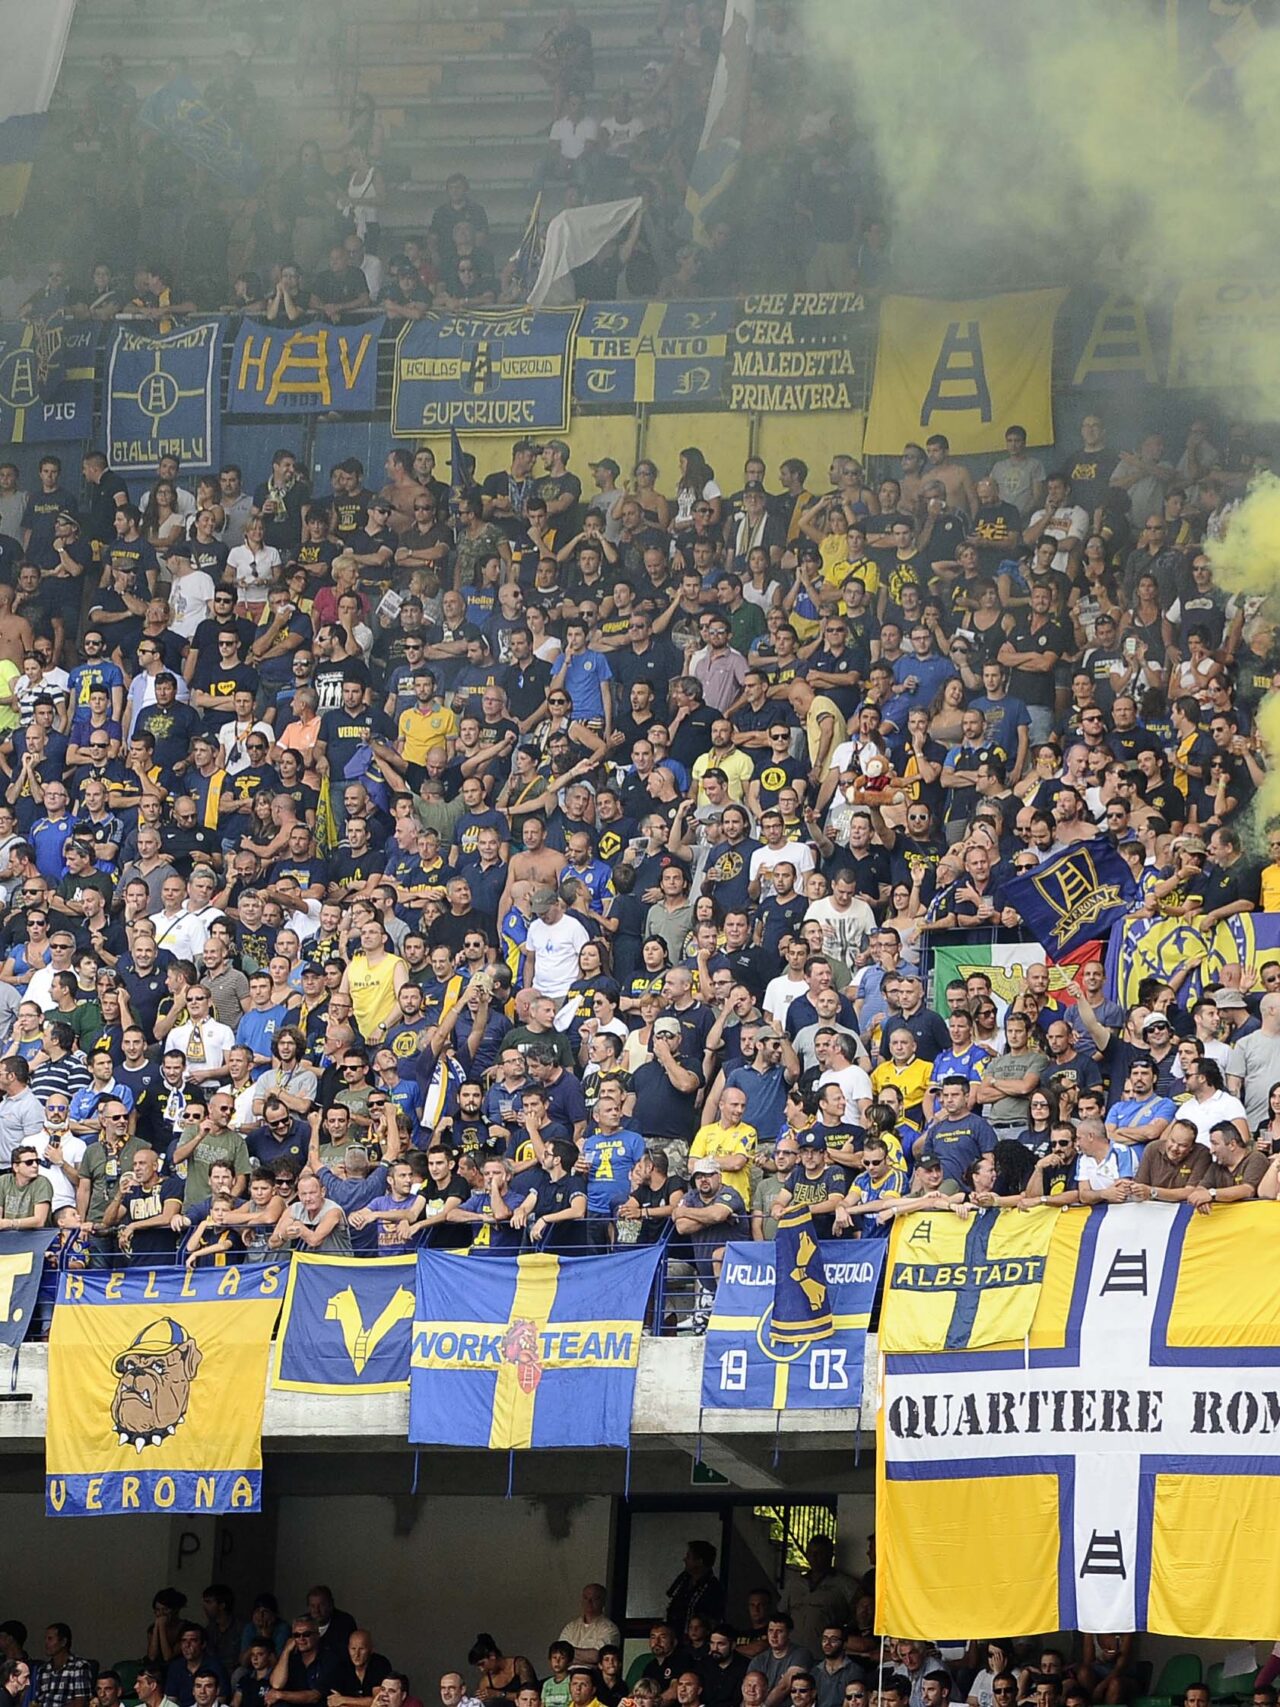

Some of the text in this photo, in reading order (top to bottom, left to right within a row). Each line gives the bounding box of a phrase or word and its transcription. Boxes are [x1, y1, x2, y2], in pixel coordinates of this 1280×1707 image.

[744, 292, 866, 316] CHE FRETTA
[405, 360, 554, 378] HELLAS VERONA
[731, 350, 856, 378] MALEDETTA
[43, 402, 76, 421] PIG
[729, 384, 854, 412] PRIMAVERA
[422, 400, 536, 425] SUPERIORE
[1066, 892, 1103, 926] VERONA
[632, 978, 665, 991] HELAS
[64, 1264, 281, 1301] HELLAS
[726, 1260, 875, 1287] HELLA ERONA
[895, 1258, 1045, 1288] ALBSTADT
[411, 1331, 633, 1364] WORK TEAM
[718, 1348, 849, 1391] 19 03
[888, 1389, 1165, 1439] QUARTIERE
[49, 1474, 255, 1512] VERONA
